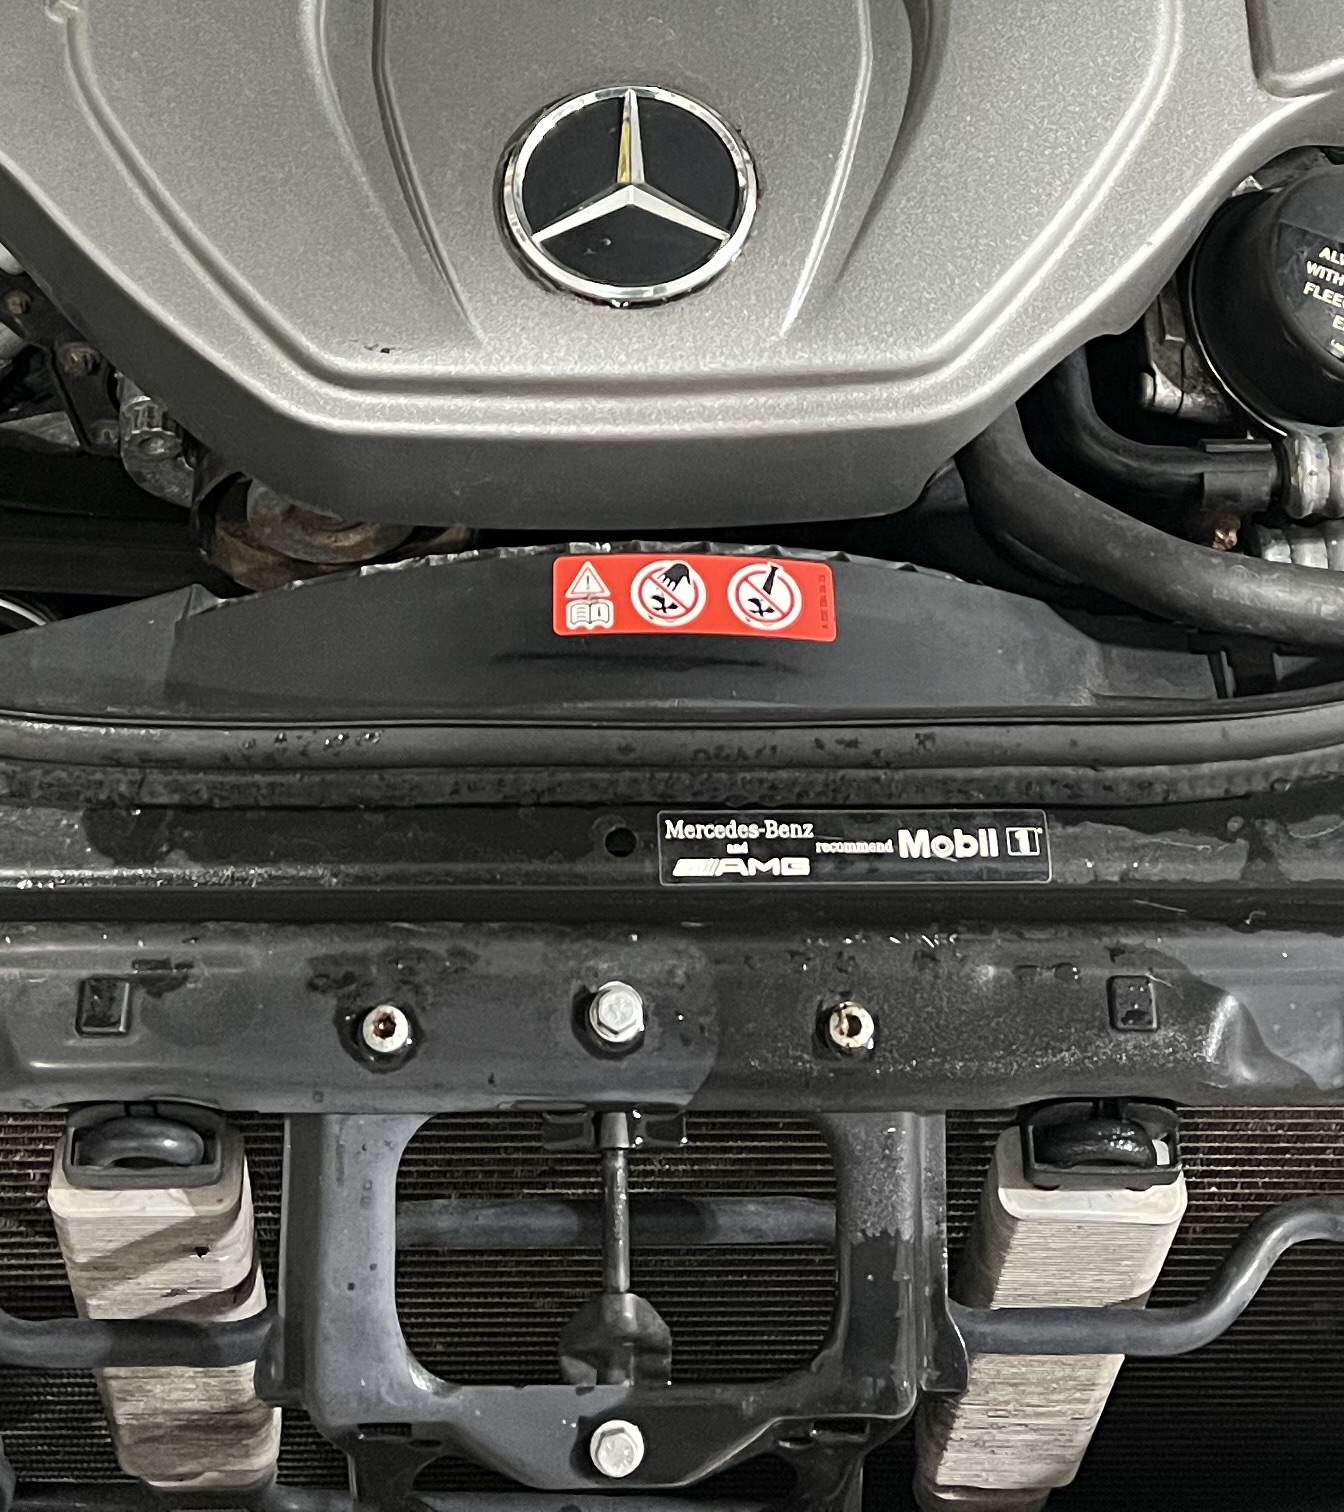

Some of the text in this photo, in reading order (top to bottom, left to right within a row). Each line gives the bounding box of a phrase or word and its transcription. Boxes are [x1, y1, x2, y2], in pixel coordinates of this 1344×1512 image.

[664, 819, 814, 840] Mercedes-Benz
[816, 838, 894, 855] recommend
[897, 828, 1000, 859] Mobil
[712, 857, 811, 876] AMG
